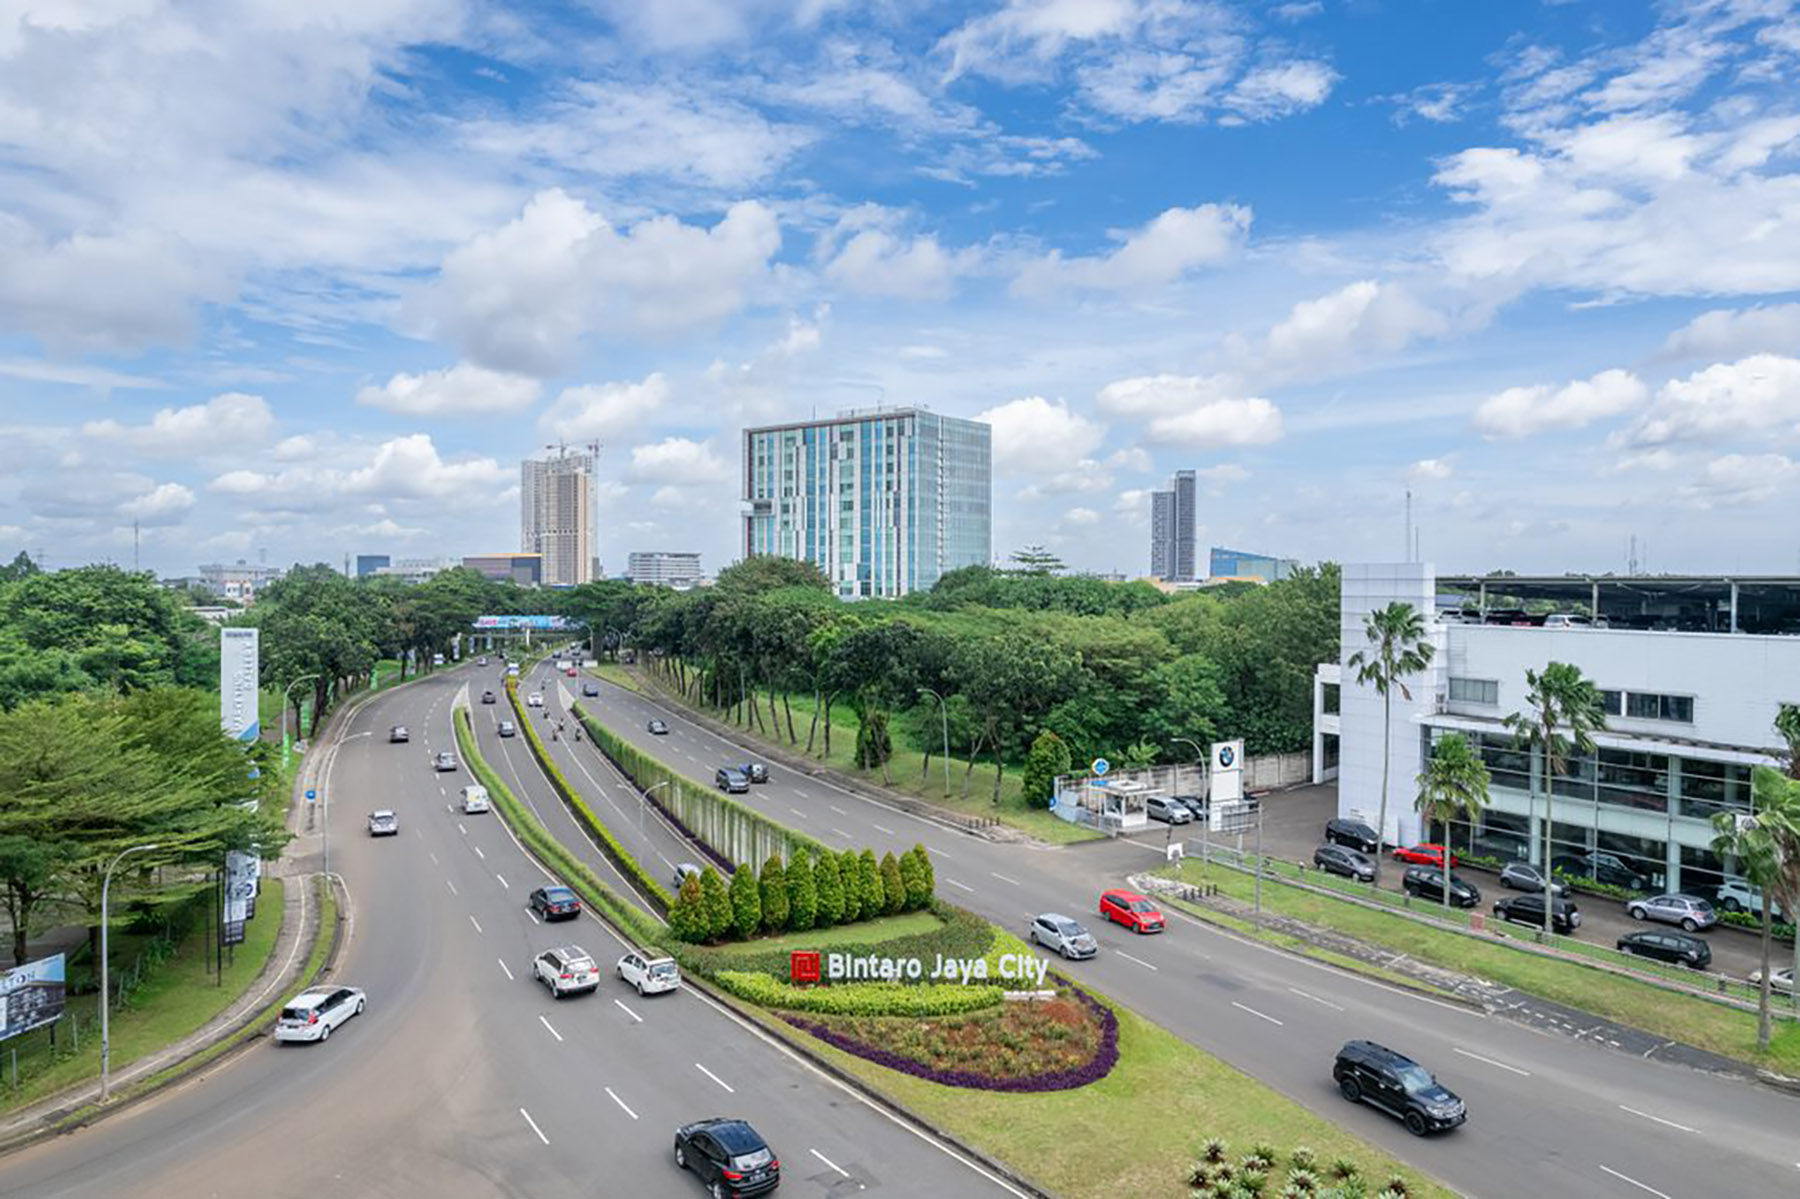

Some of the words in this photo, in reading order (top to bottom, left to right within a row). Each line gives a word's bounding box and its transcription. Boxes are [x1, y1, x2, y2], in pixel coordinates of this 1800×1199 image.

[828, 953, 921, 978] Bintaro
[930, 953, 988, 985] Jaya
[998, 953, 1049, 985] City
